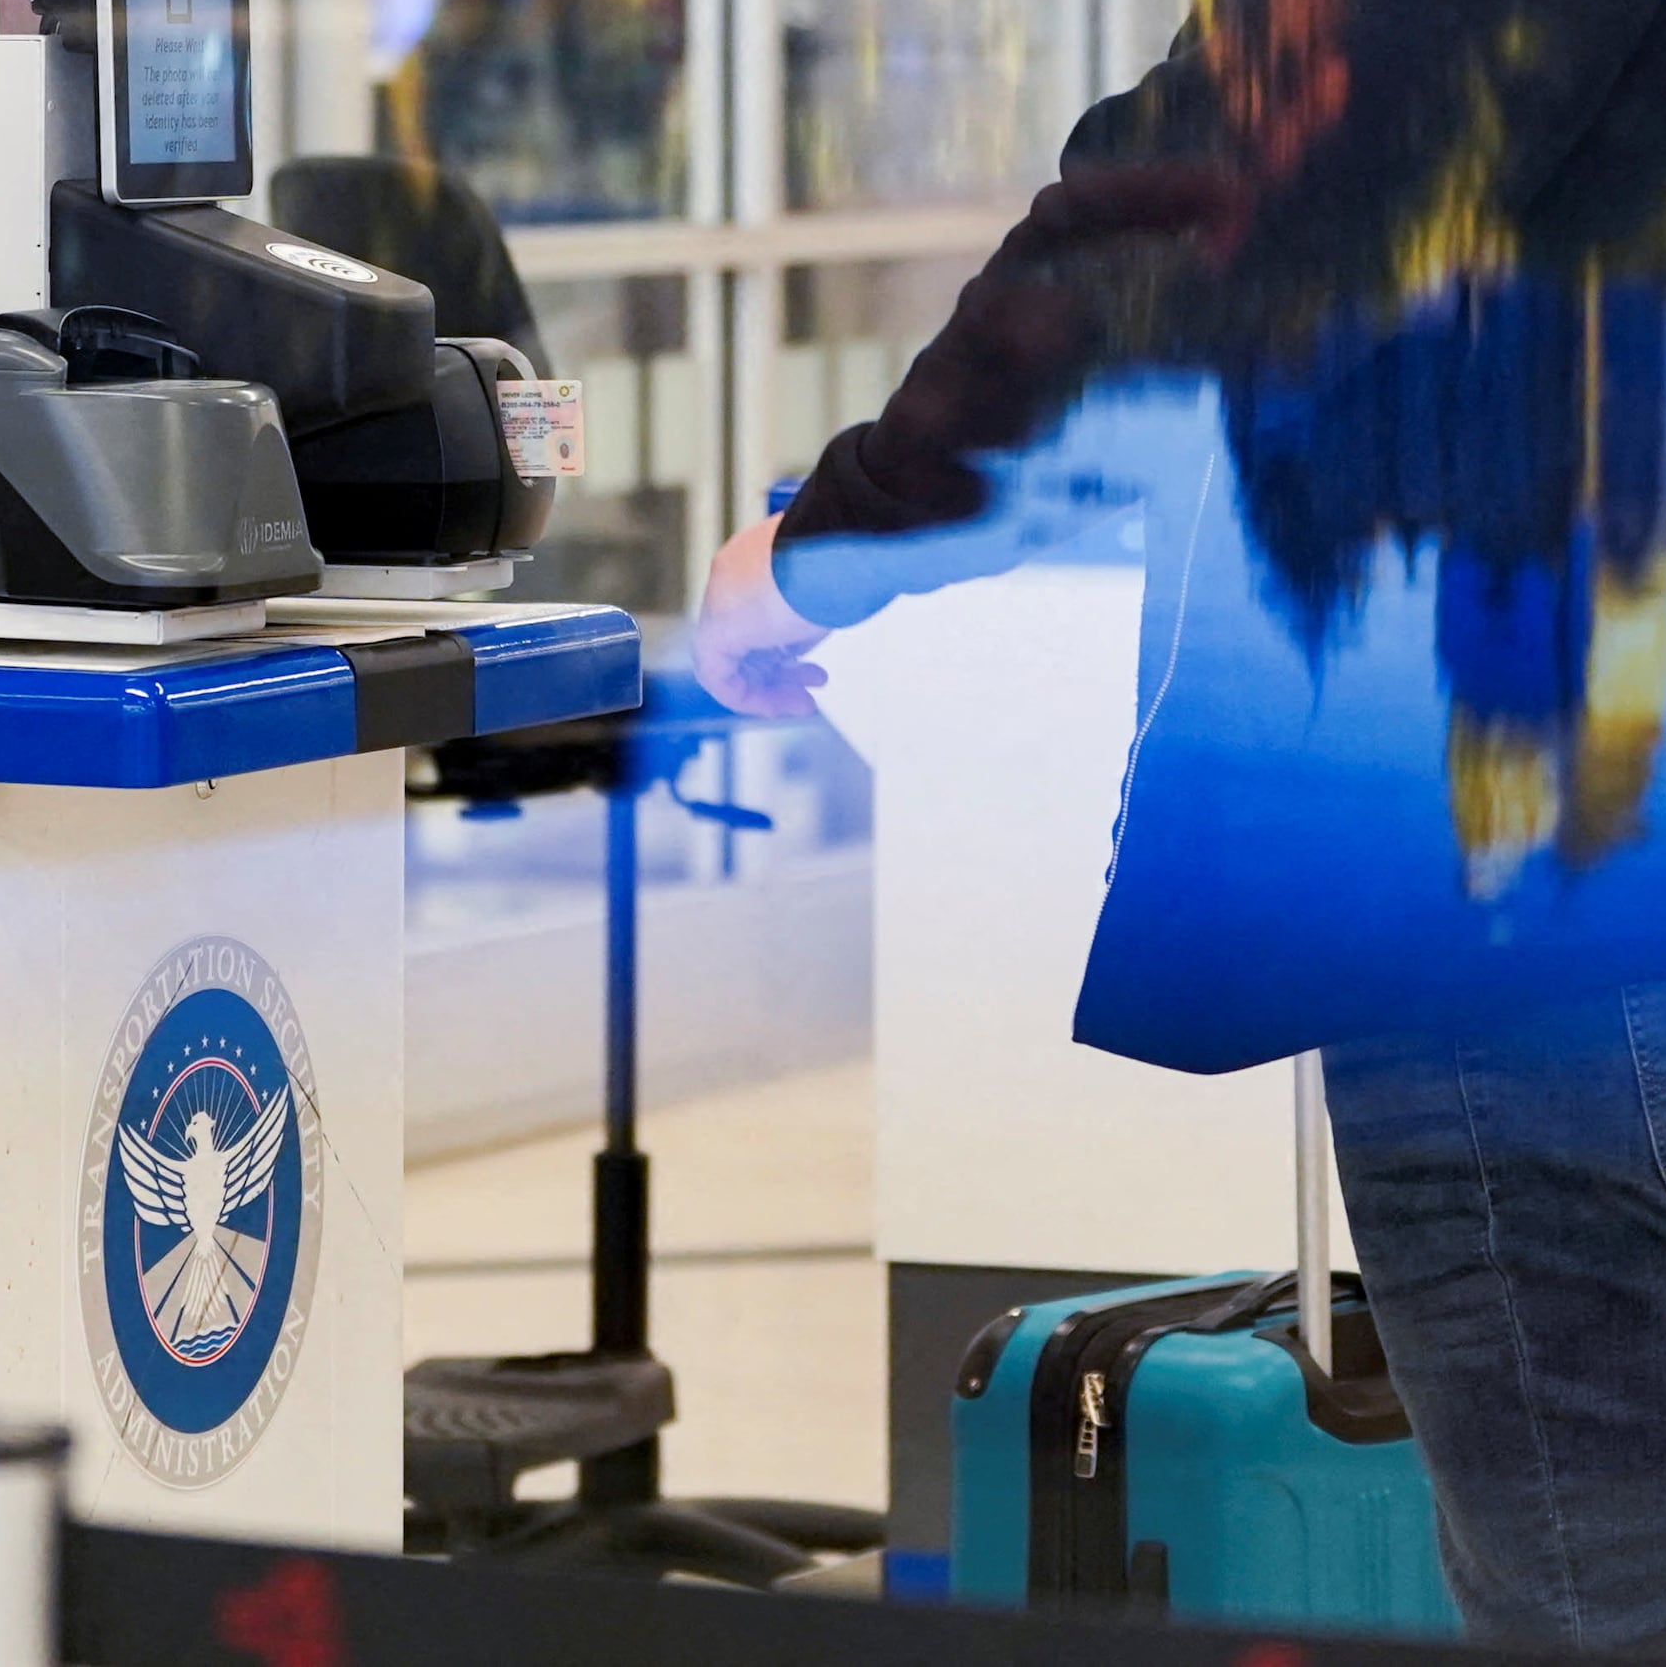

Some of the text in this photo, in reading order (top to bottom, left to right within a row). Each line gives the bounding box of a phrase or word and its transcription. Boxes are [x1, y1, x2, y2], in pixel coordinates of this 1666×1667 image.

[155, 37, 182, 53] Please
[142, 93, 173, 106] deleted
[261, 521, 303, 542] IDEMIA
[83, 943, 325, 1274] TRANSPORTATION SECURITY
[96, 1302, 306, 1480] ADMINISTRATION
